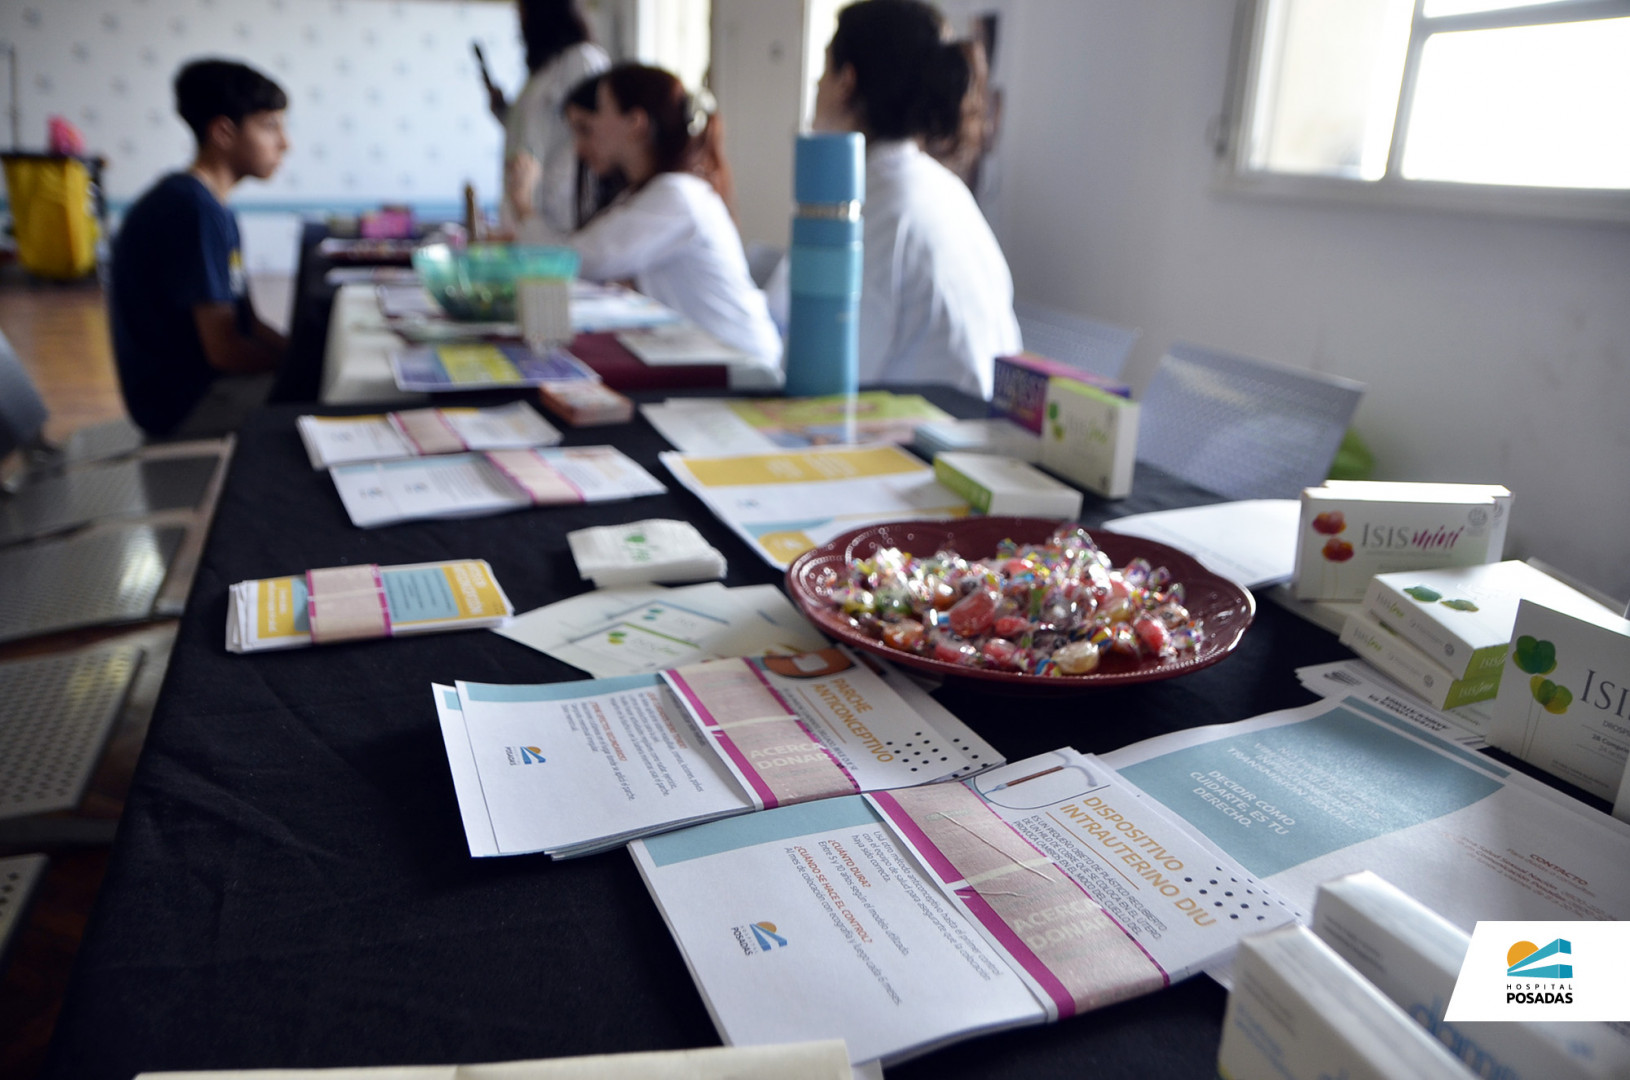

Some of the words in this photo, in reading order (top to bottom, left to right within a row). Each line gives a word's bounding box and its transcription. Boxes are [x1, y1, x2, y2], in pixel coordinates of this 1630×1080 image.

[1580, 669, 1630, 720] ISI
[812, 684, 894, 763] ANTICONCEPTIVO
[1207, 770, 1257, 801] DECIDIR
[1189, 771, 1251, 813] CUIDARTE,
[1249, 808, 1270, 824] ES
[1267, 822, 1290, 836] TU
[1193, 787, 1252, 829] DERECHO.
[1082, 795, 1185, 872] DISPOSITIVO
[795, 864, 809, 872] de
[814, 873, 828, 882] SE
[816, 840, 835, 856] Entre
[839, 871, 857, 885] años
[848, 866, 873, 888] DURA?
[887, 865, 901, 874] de
[1058, 803, 1181, 898] INTRAUTERINO
[1174, 896, 1219, 928] DIU
[1073, 861, 1092, 874] QUE
[1086, 872, 1099, 880] SE
[1089, 863, 1103, 872] DE
[820, 882, 841, 900] HACE
[833, 900, 847, 909] EL
[1073, 872, 1097, 890] MOCO
[1090, 888, 1109, 901] DEL
[1102, 899, 1133, 923] CUELLO
[840, 909, 874, 944] CONTROL?
